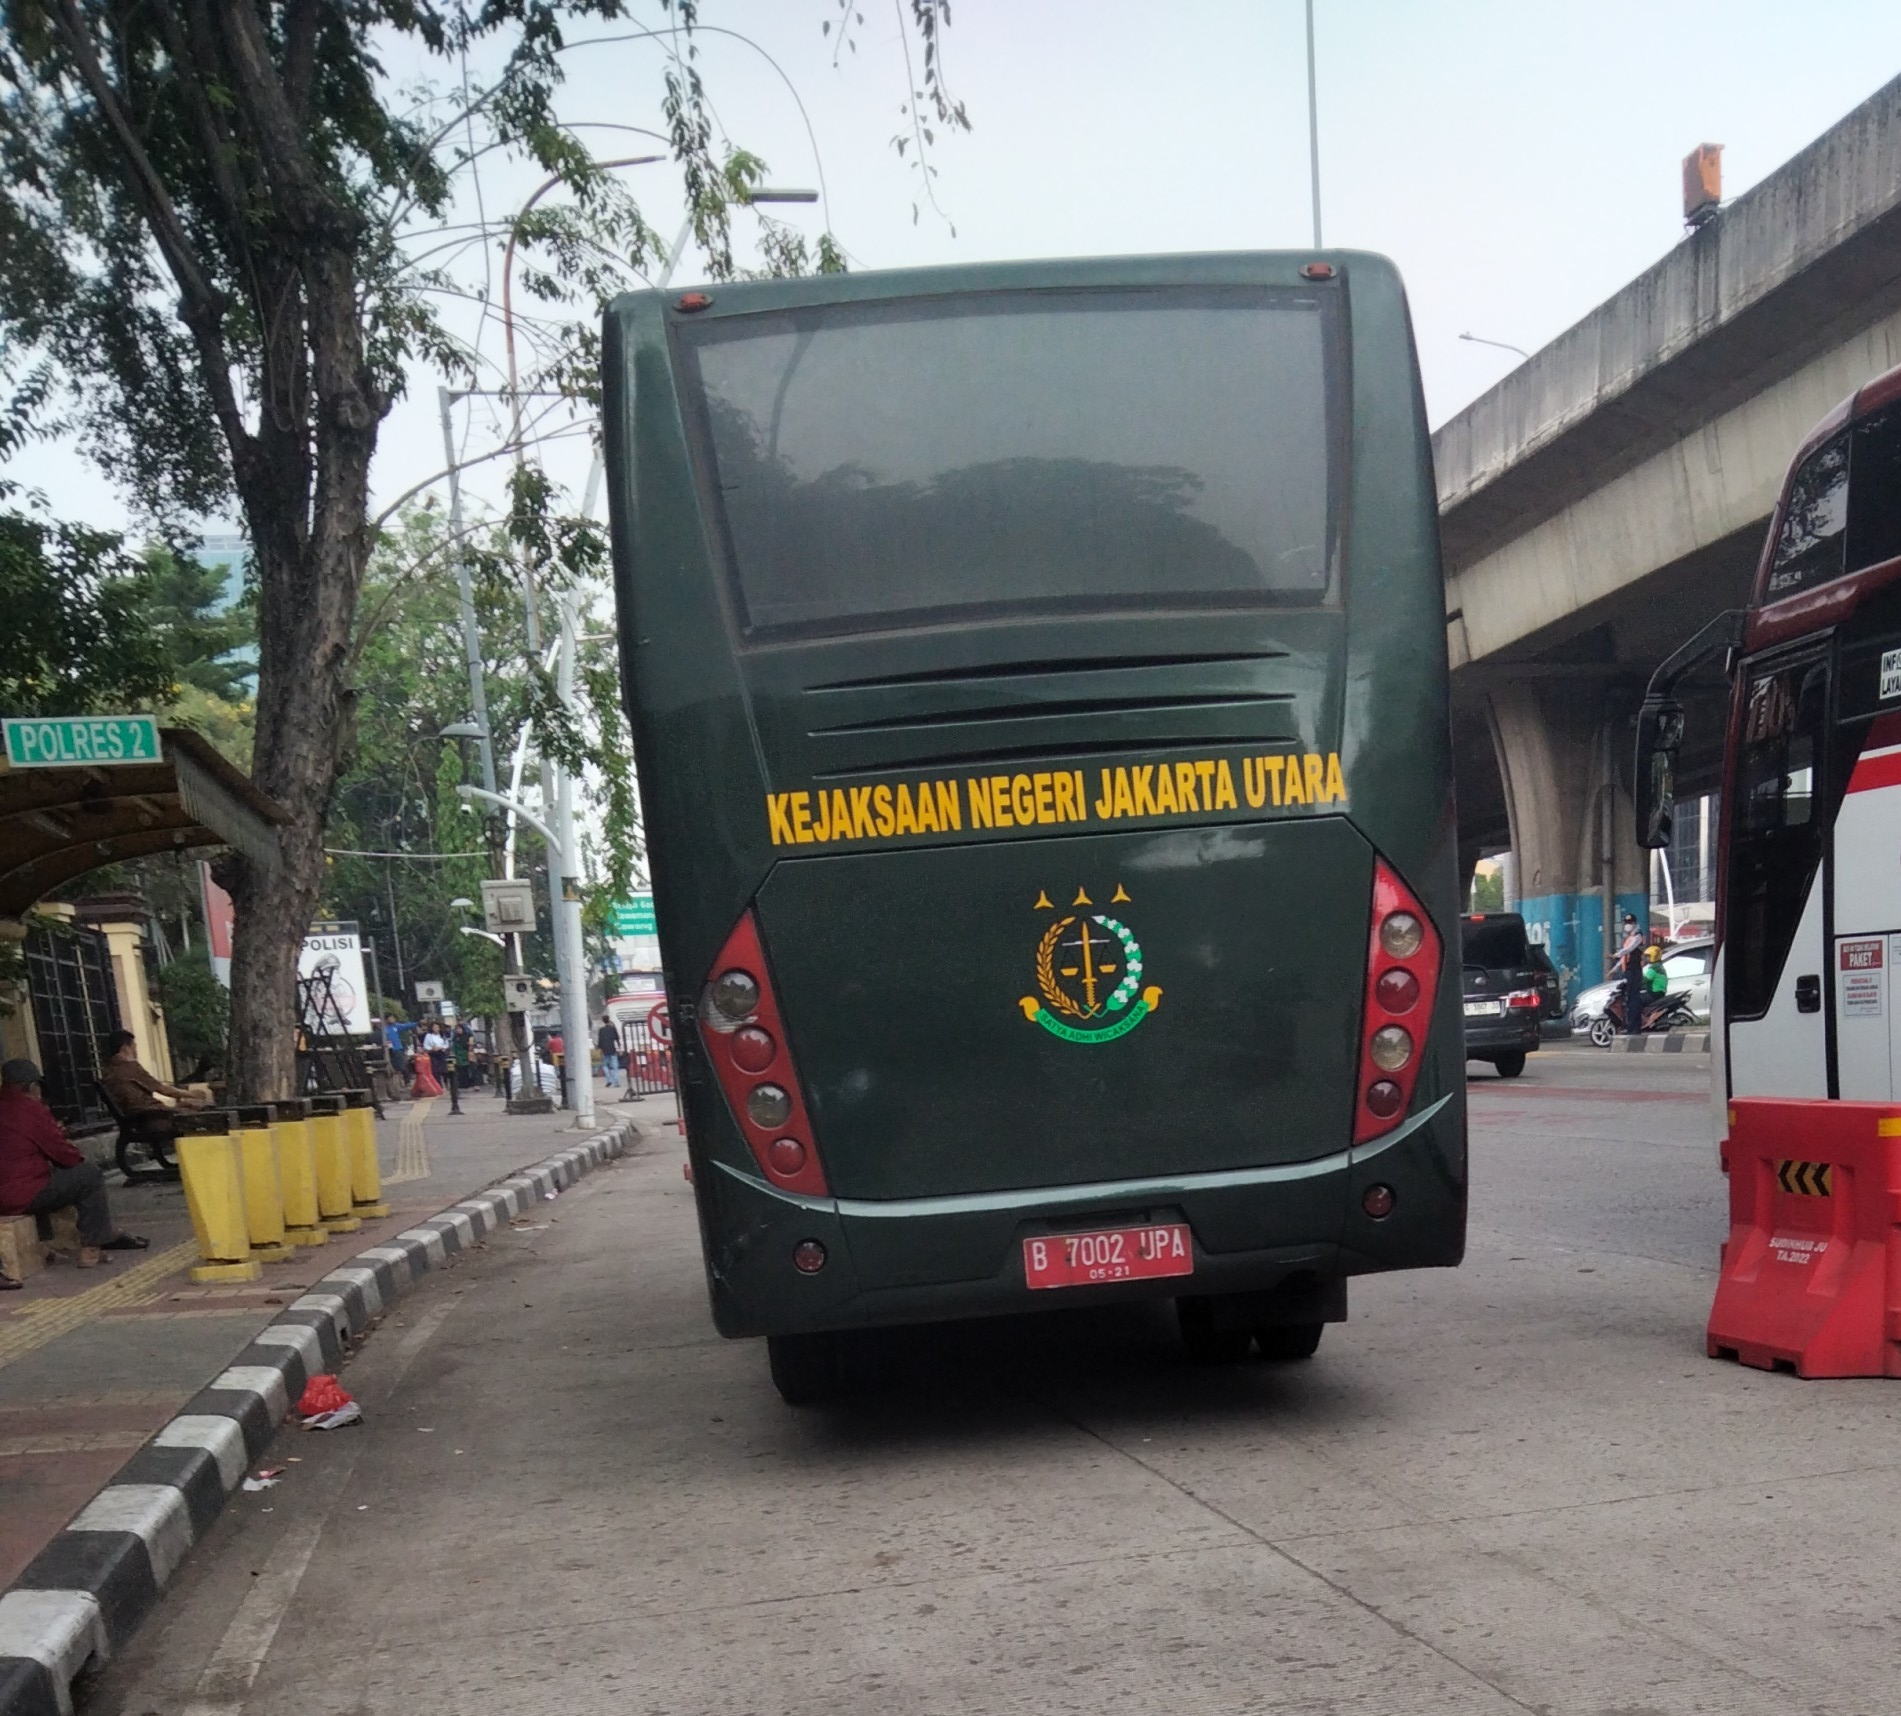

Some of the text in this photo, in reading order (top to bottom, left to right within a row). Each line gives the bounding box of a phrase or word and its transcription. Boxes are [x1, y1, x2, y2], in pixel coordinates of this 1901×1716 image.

[20, 722, 146, 761] POLRES 2
[767, 752, 1347, 845] KEJAKSAAN NEGERI JAKARTA UTARA
[1849, 952, 1873, 968] PAKET
[1041, 1004, 1148, 1042] SATYA ADHI WICAKSANA
[1032, 1228, 1185, 1271] B 7002 UPA
